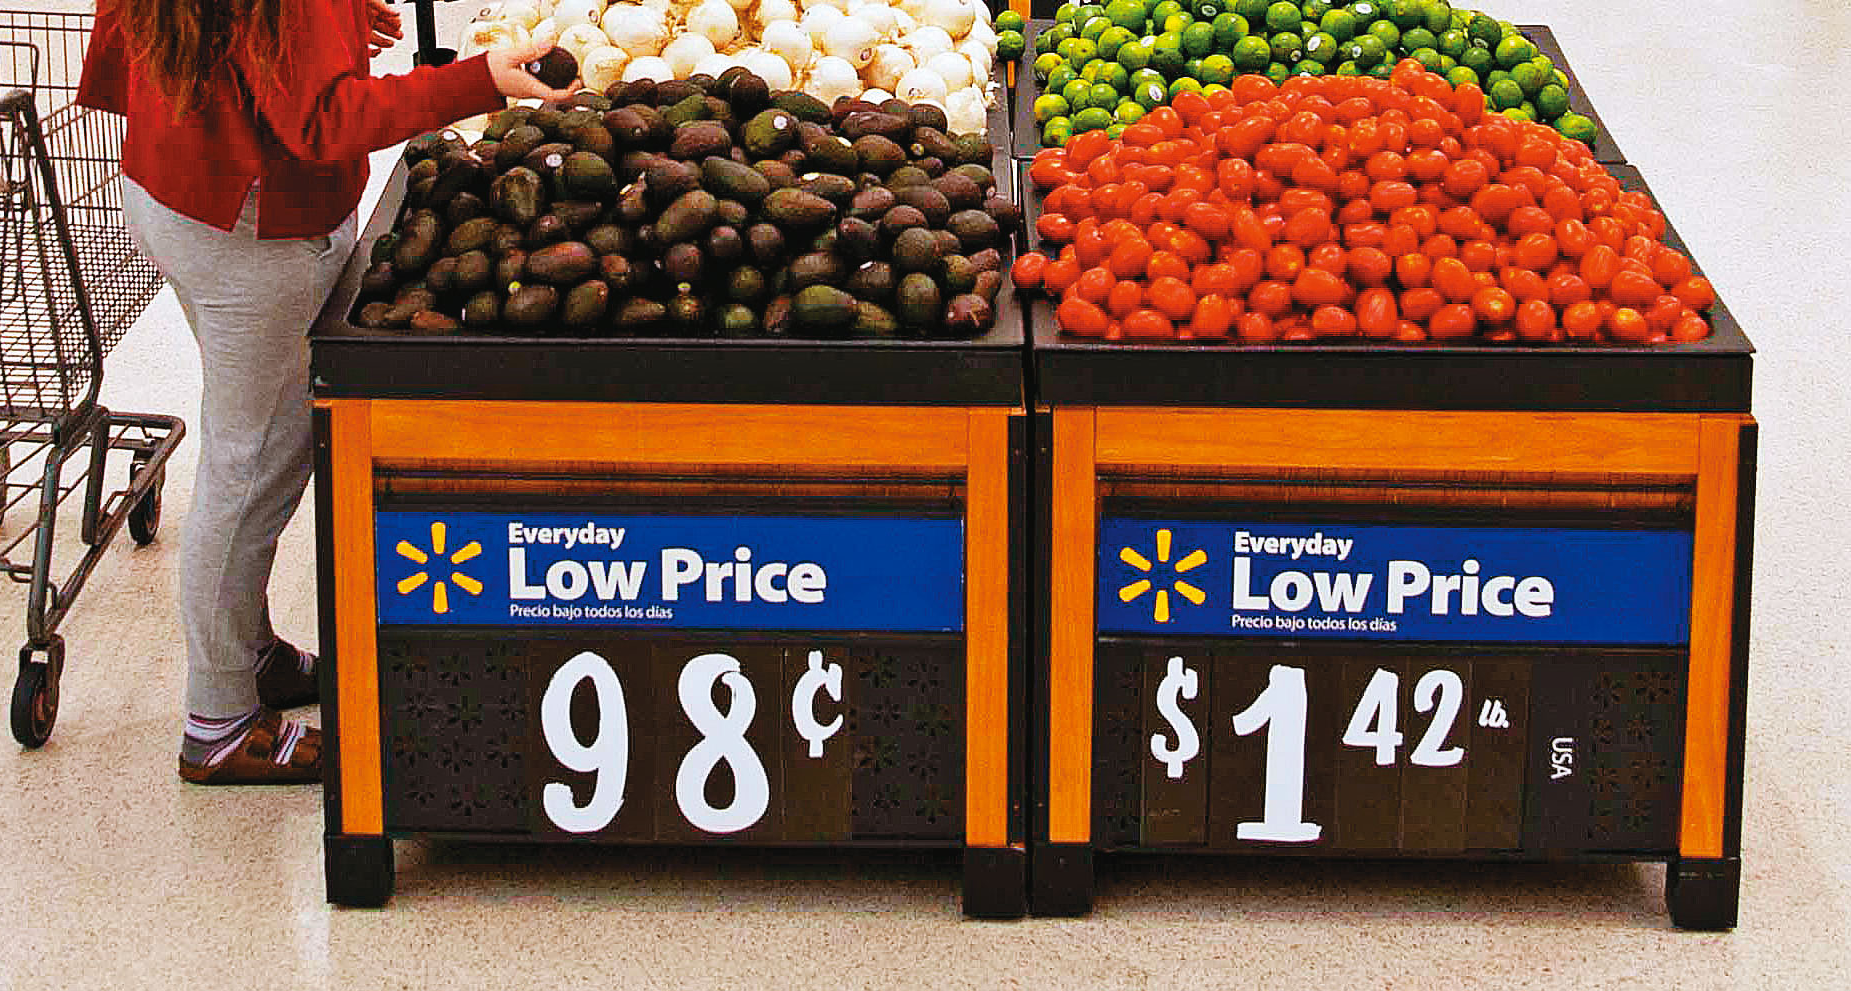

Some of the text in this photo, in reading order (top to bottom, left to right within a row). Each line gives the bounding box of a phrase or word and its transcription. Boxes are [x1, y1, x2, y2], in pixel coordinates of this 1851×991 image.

[508, 522, 625, 549] Everyday
[1234, 531, 1353, 560] Everyday
[509, 546, 827, 603] Low Price
[1232, 556, 1554, 616] Low Price
[509, 604, 673, 620] Precio bajo todos los días
[1232, 614, 1397, 632] Precio bajo todos los días
[1479, 699, 1509, 729] lb.
[541, 650, 844, 833] 98¢
[1150, 656, 1465, 842] $142
[1550, 737, 1573, 779] USA
